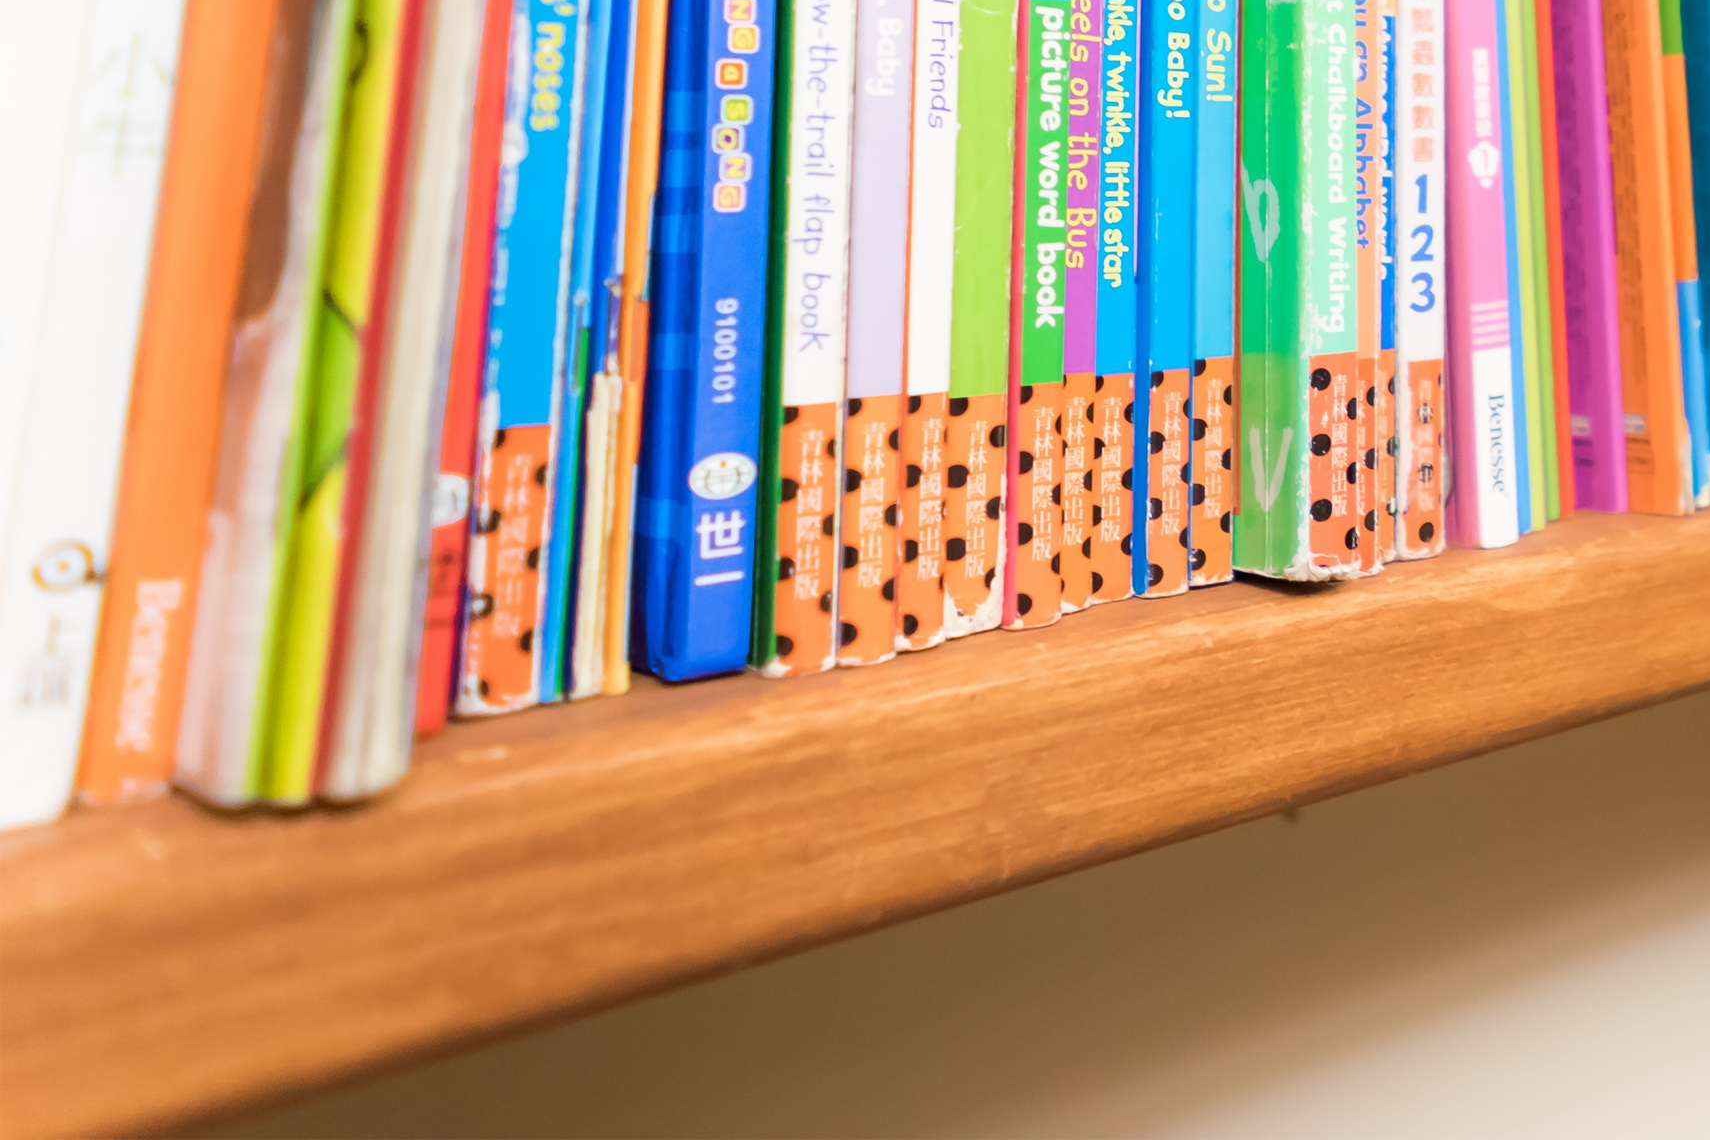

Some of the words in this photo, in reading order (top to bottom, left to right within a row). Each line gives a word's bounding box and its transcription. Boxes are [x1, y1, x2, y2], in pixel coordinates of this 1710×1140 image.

[530, 22, 564, 132] noses
[864, 16, 904, 99] Baby
[926, 20, 956, 130] Friends
[1034, 5, 1068, 131] picture
[1067, 77, 1091, 118] on
[1103, 52, 1132, 154] twinkle,
[1157, 31, 1190, 120] Baby!
[1204, 28, 1234, 104] Sun!
[1065, 132, 1099, 191] the
[1325, 22, 1349, 204] Chalkboard
[792, 191, 836, 257] flap
[1035, 140, 1066, 230] word
[1064, 204, 1099, 272] Bus
[1102, 160, 1131, 226] little
[1033, 241, 1066, 329] book
[1102, 227, 1124, 288] star
[1319, 215, 1349, 335] Writing
[712, 297, 739, 404] 9100101
[799, 272, 838, 354] book
[1030, 405, 1058, 564] 青林國際出版
[1062, 396, 1089, 547] 青林國際出版
[1098, 395, 1124, 542] 青林國際出版
[1157, 390, 1183, 537] 青林國際出版
[1201, 376, 1226, 519] 青林國際出版
[1331, 373, 1349, 517] 青林國際出版
[1488, 393, 1506, 494] Benesse
[694, 509, 745, 587] 世一
[792, 427, 825, 602] 青林國際出版
[856, 420, 886, 590] 青林國際出版
[916, 417, 945, 581] 青林國際出版
[963, 418, 989, 579] 青林國際出版
